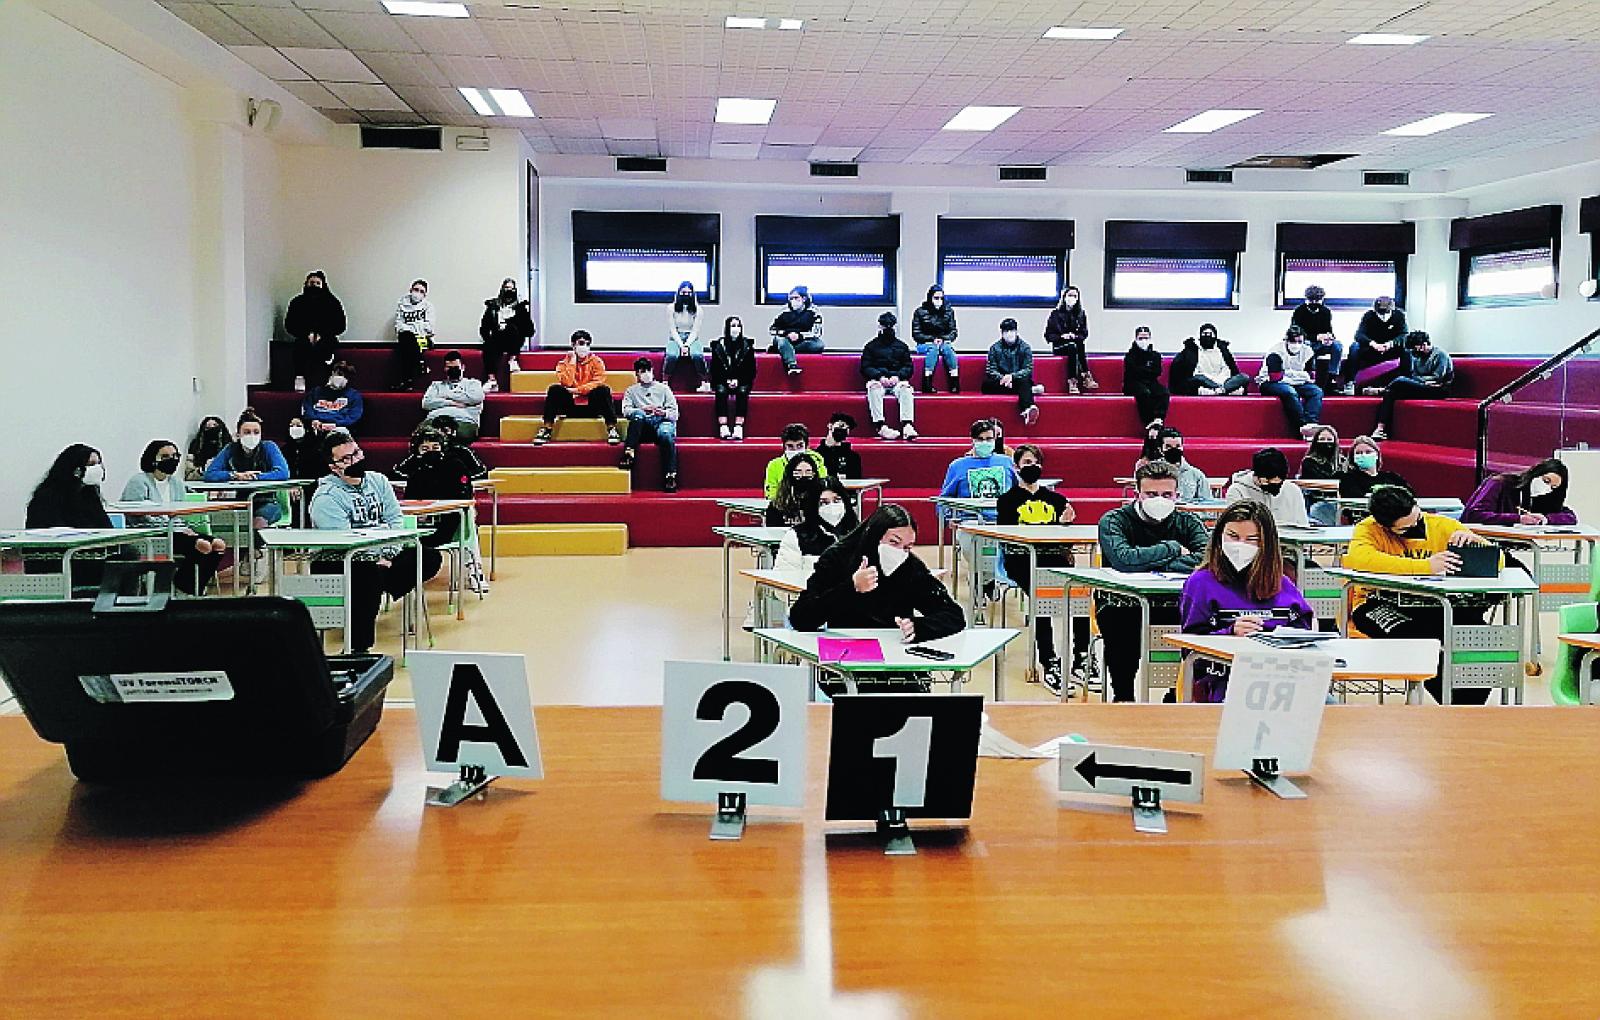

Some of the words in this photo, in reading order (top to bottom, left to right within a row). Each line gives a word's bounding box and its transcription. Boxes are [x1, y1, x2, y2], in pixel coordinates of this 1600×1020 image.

[435, 663, 529, 768] A
[692, 680, 781, 784] 2
[872, 716, 933, 807] 1
